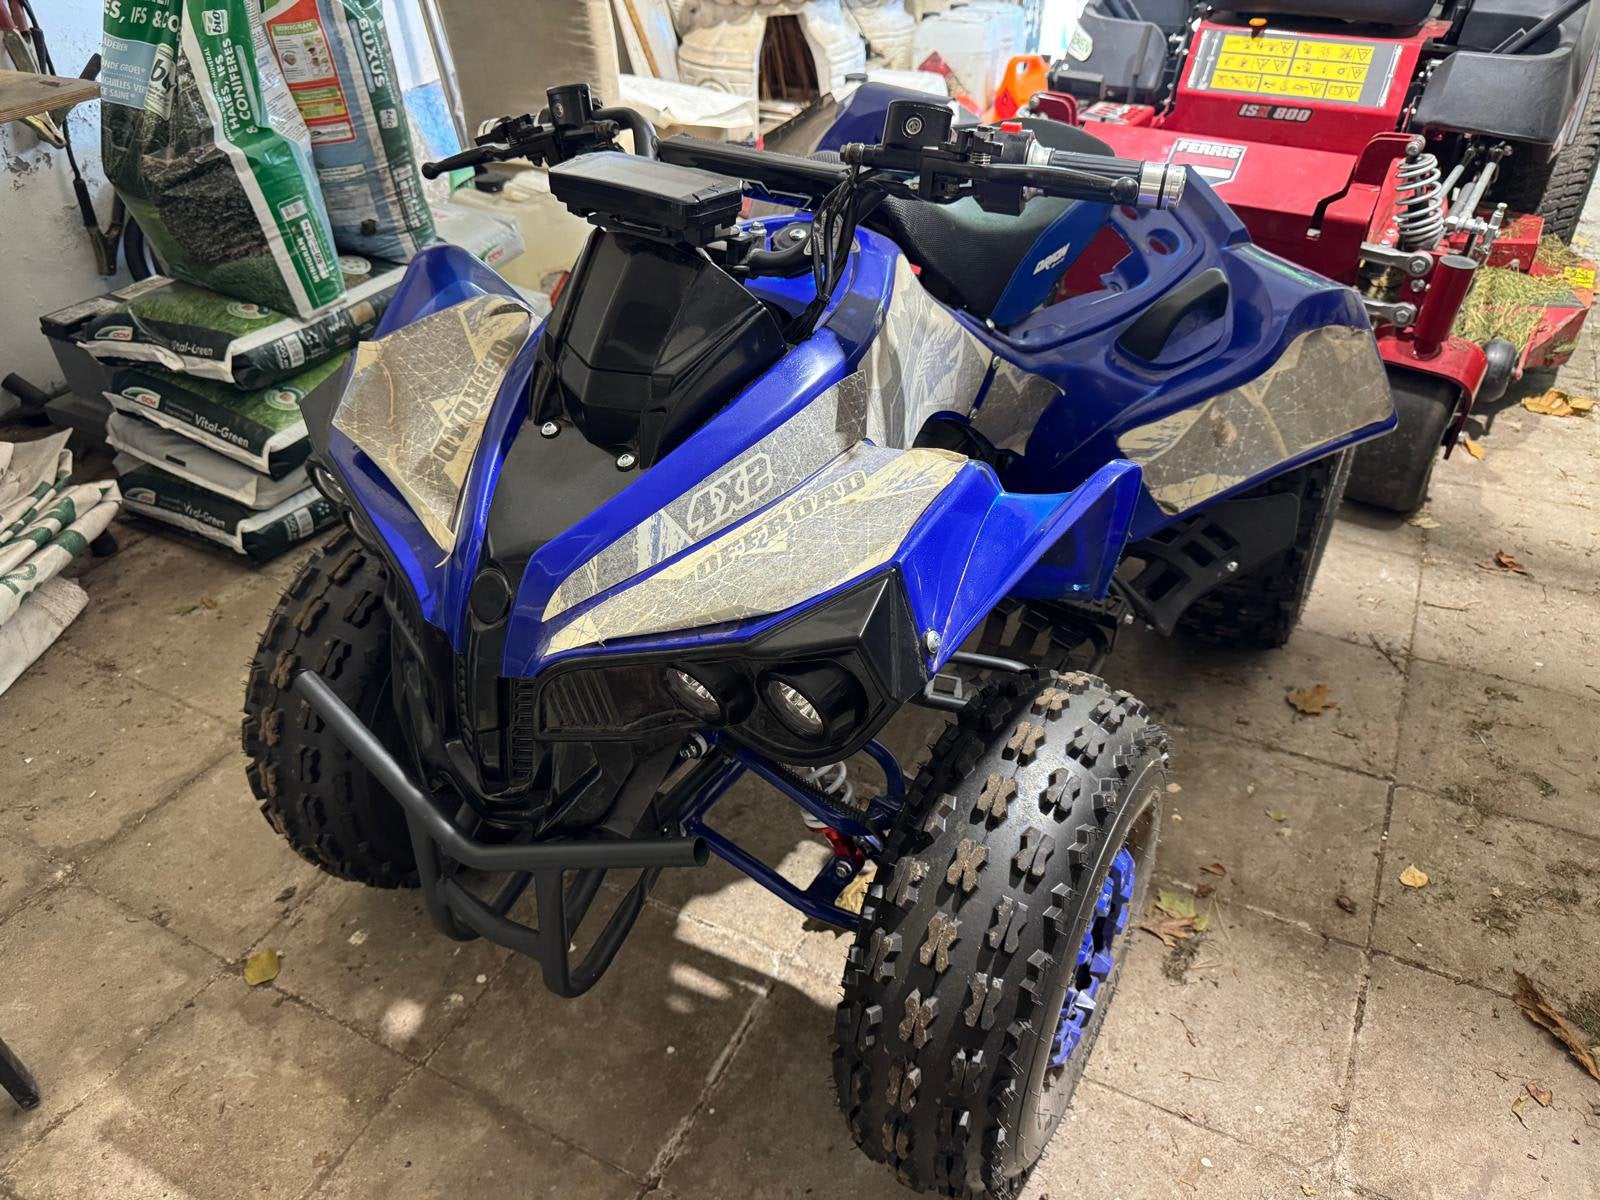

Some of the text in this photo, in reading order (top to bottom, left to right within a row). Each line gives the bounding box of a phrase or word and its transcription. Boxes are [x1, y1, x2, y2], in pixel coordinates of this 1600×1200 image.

[130, 6, 148, 25] IFS
[359, 17, 386, 88] BUXUS
[215, 54, 240, 130] HAIES, IFS
[222, 38, 251, 121] CONIFERES
[1273, 108, 1312, 122] 800
[1176, 141, 1243, 159] FERRIS
[195, 413, 249, 448] Vital-Green
